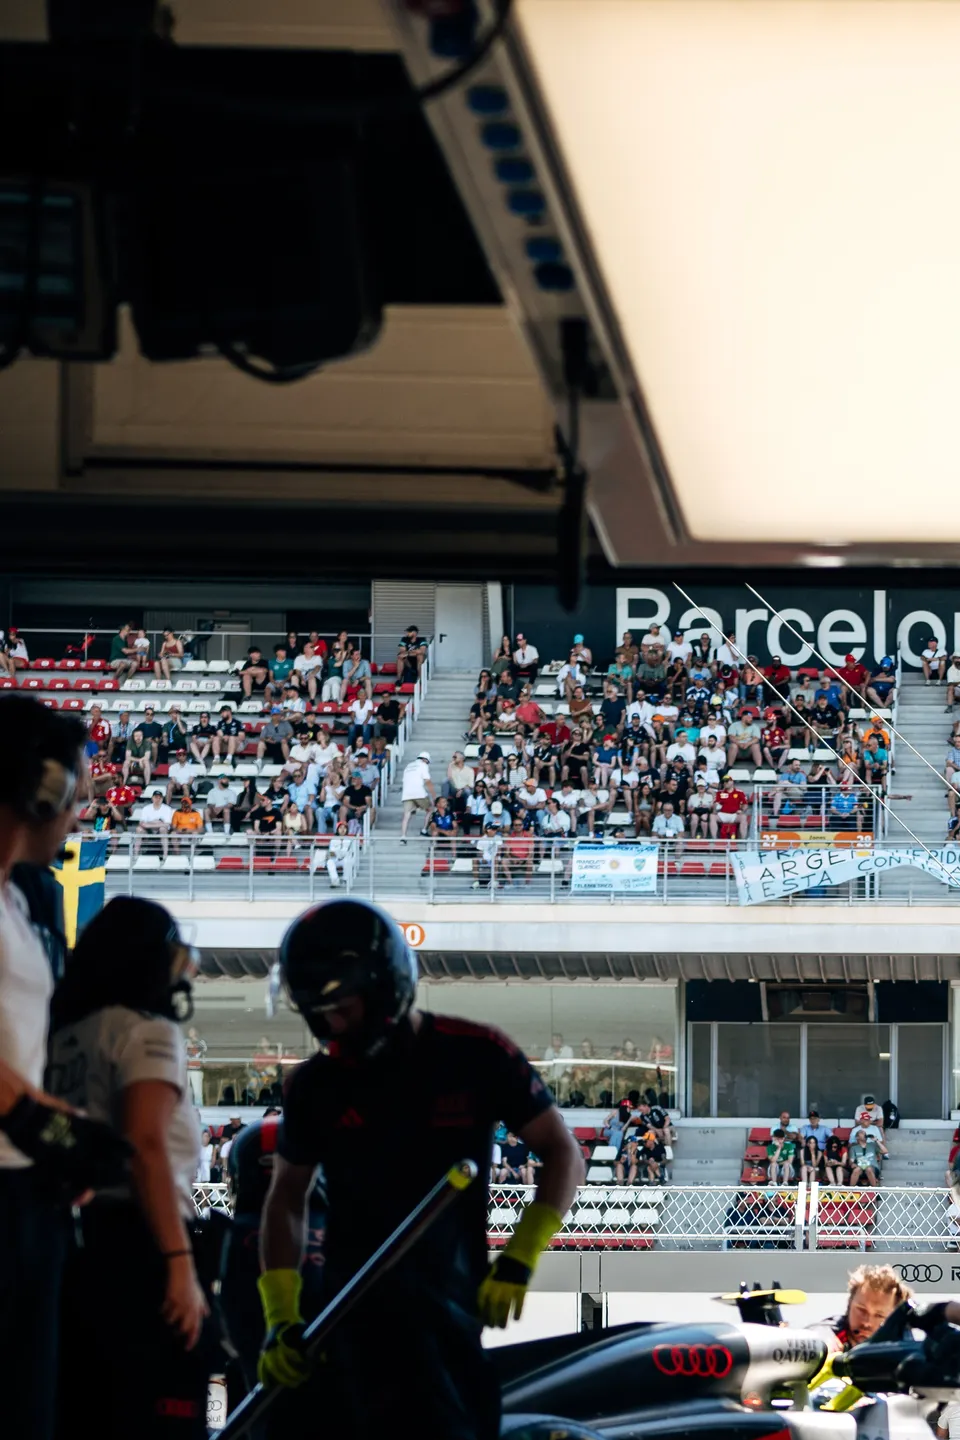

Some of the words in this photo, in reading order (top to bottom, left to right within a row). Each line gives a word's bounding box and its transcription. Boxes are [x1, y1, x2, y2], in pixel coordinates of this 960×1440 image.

[762, 834, 778, 847] 27
[762, 870, 833, 898] ESTA
[399, 924, 421, 946] 0
